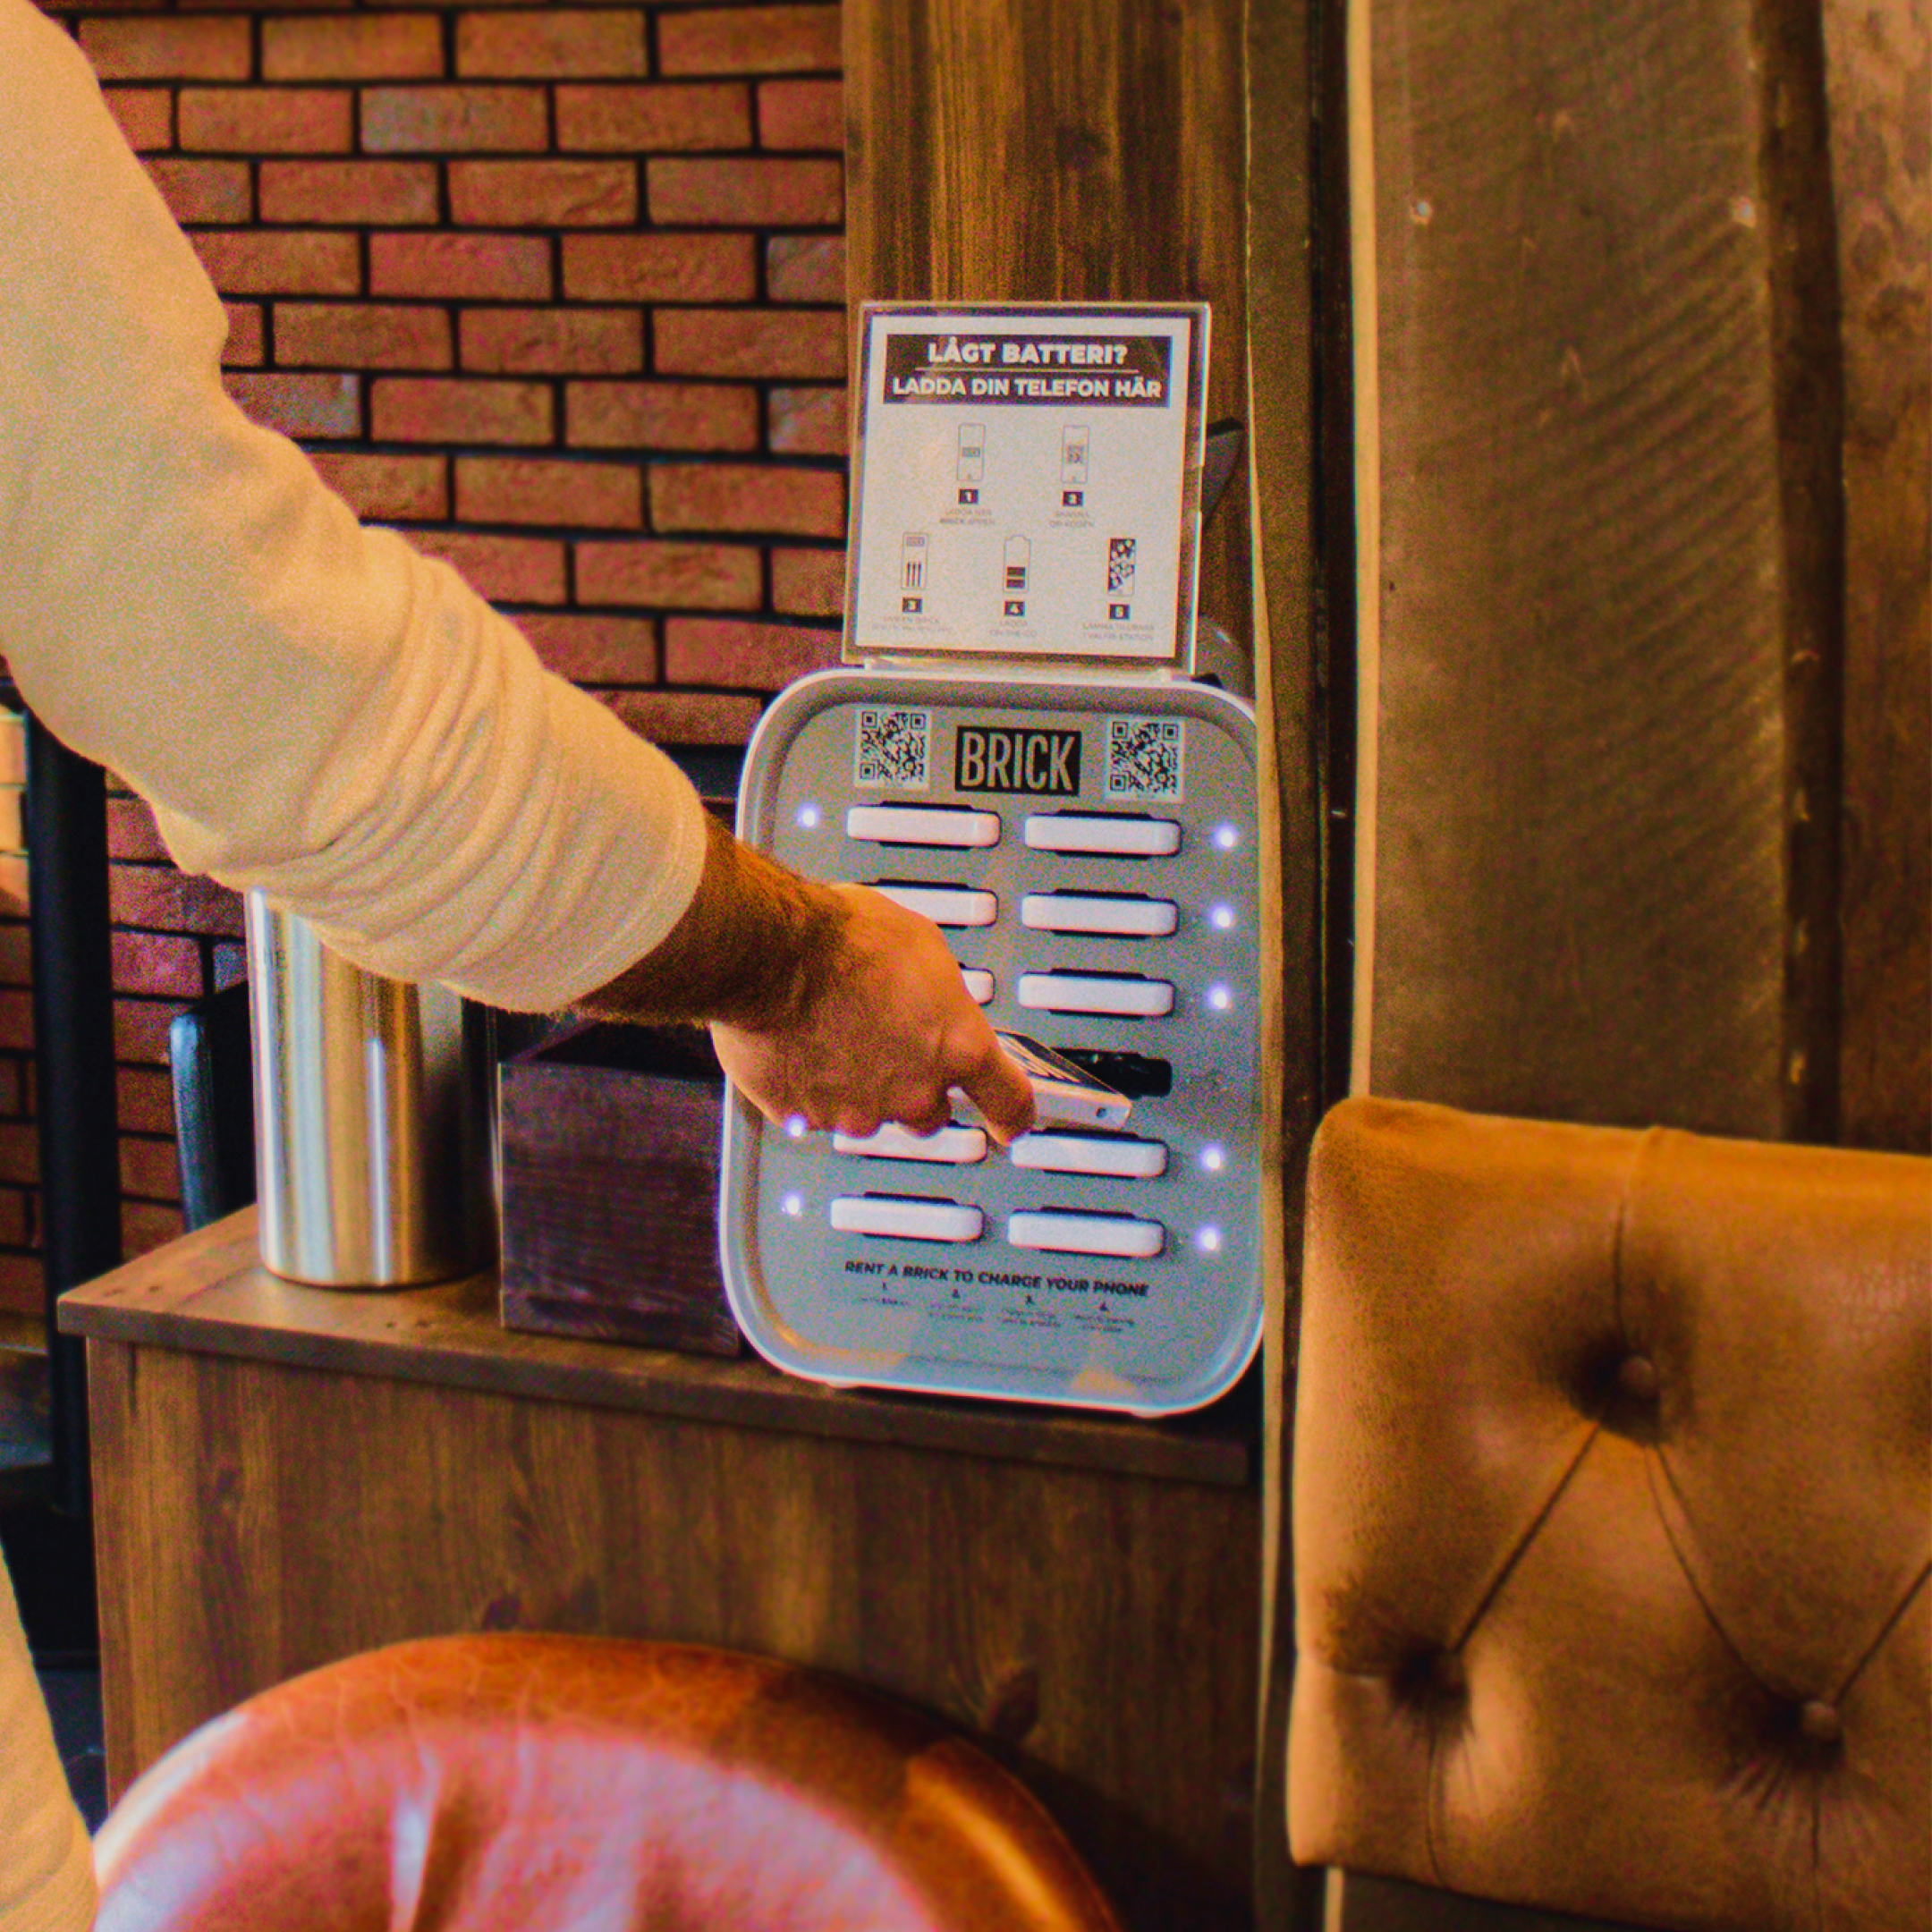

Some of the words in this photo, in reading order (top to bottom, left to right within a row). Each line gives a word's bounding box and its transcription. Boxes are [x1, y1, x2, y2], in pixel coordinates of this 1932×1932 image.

[928, 337, 996, 363] LÅGT
[1002, 343, 1129, 365] BATTERI?
[893, 377, 966, 396] LADDA
[971, 378, 1010, 396] DIN
[1015, 378, 1110, 398] TELEFON
[1115, 376, 1162, 399] HÄR
[1009, 603, 1021, 614] 4
[960, 731, 1077, 791] BRICK
[845, 1261, 885, 1275] RENT
[888, 1264, 898, 1275] A
[902, 1265, 948, 1281] BRICK
[953, 1268, 974, 1283] TO
[978, 1271, 1041, 1290] CHARGE
[1046, 1276, 1089, 1292] YOUR
[1093, 1280, 1149, 1297] PHONE
